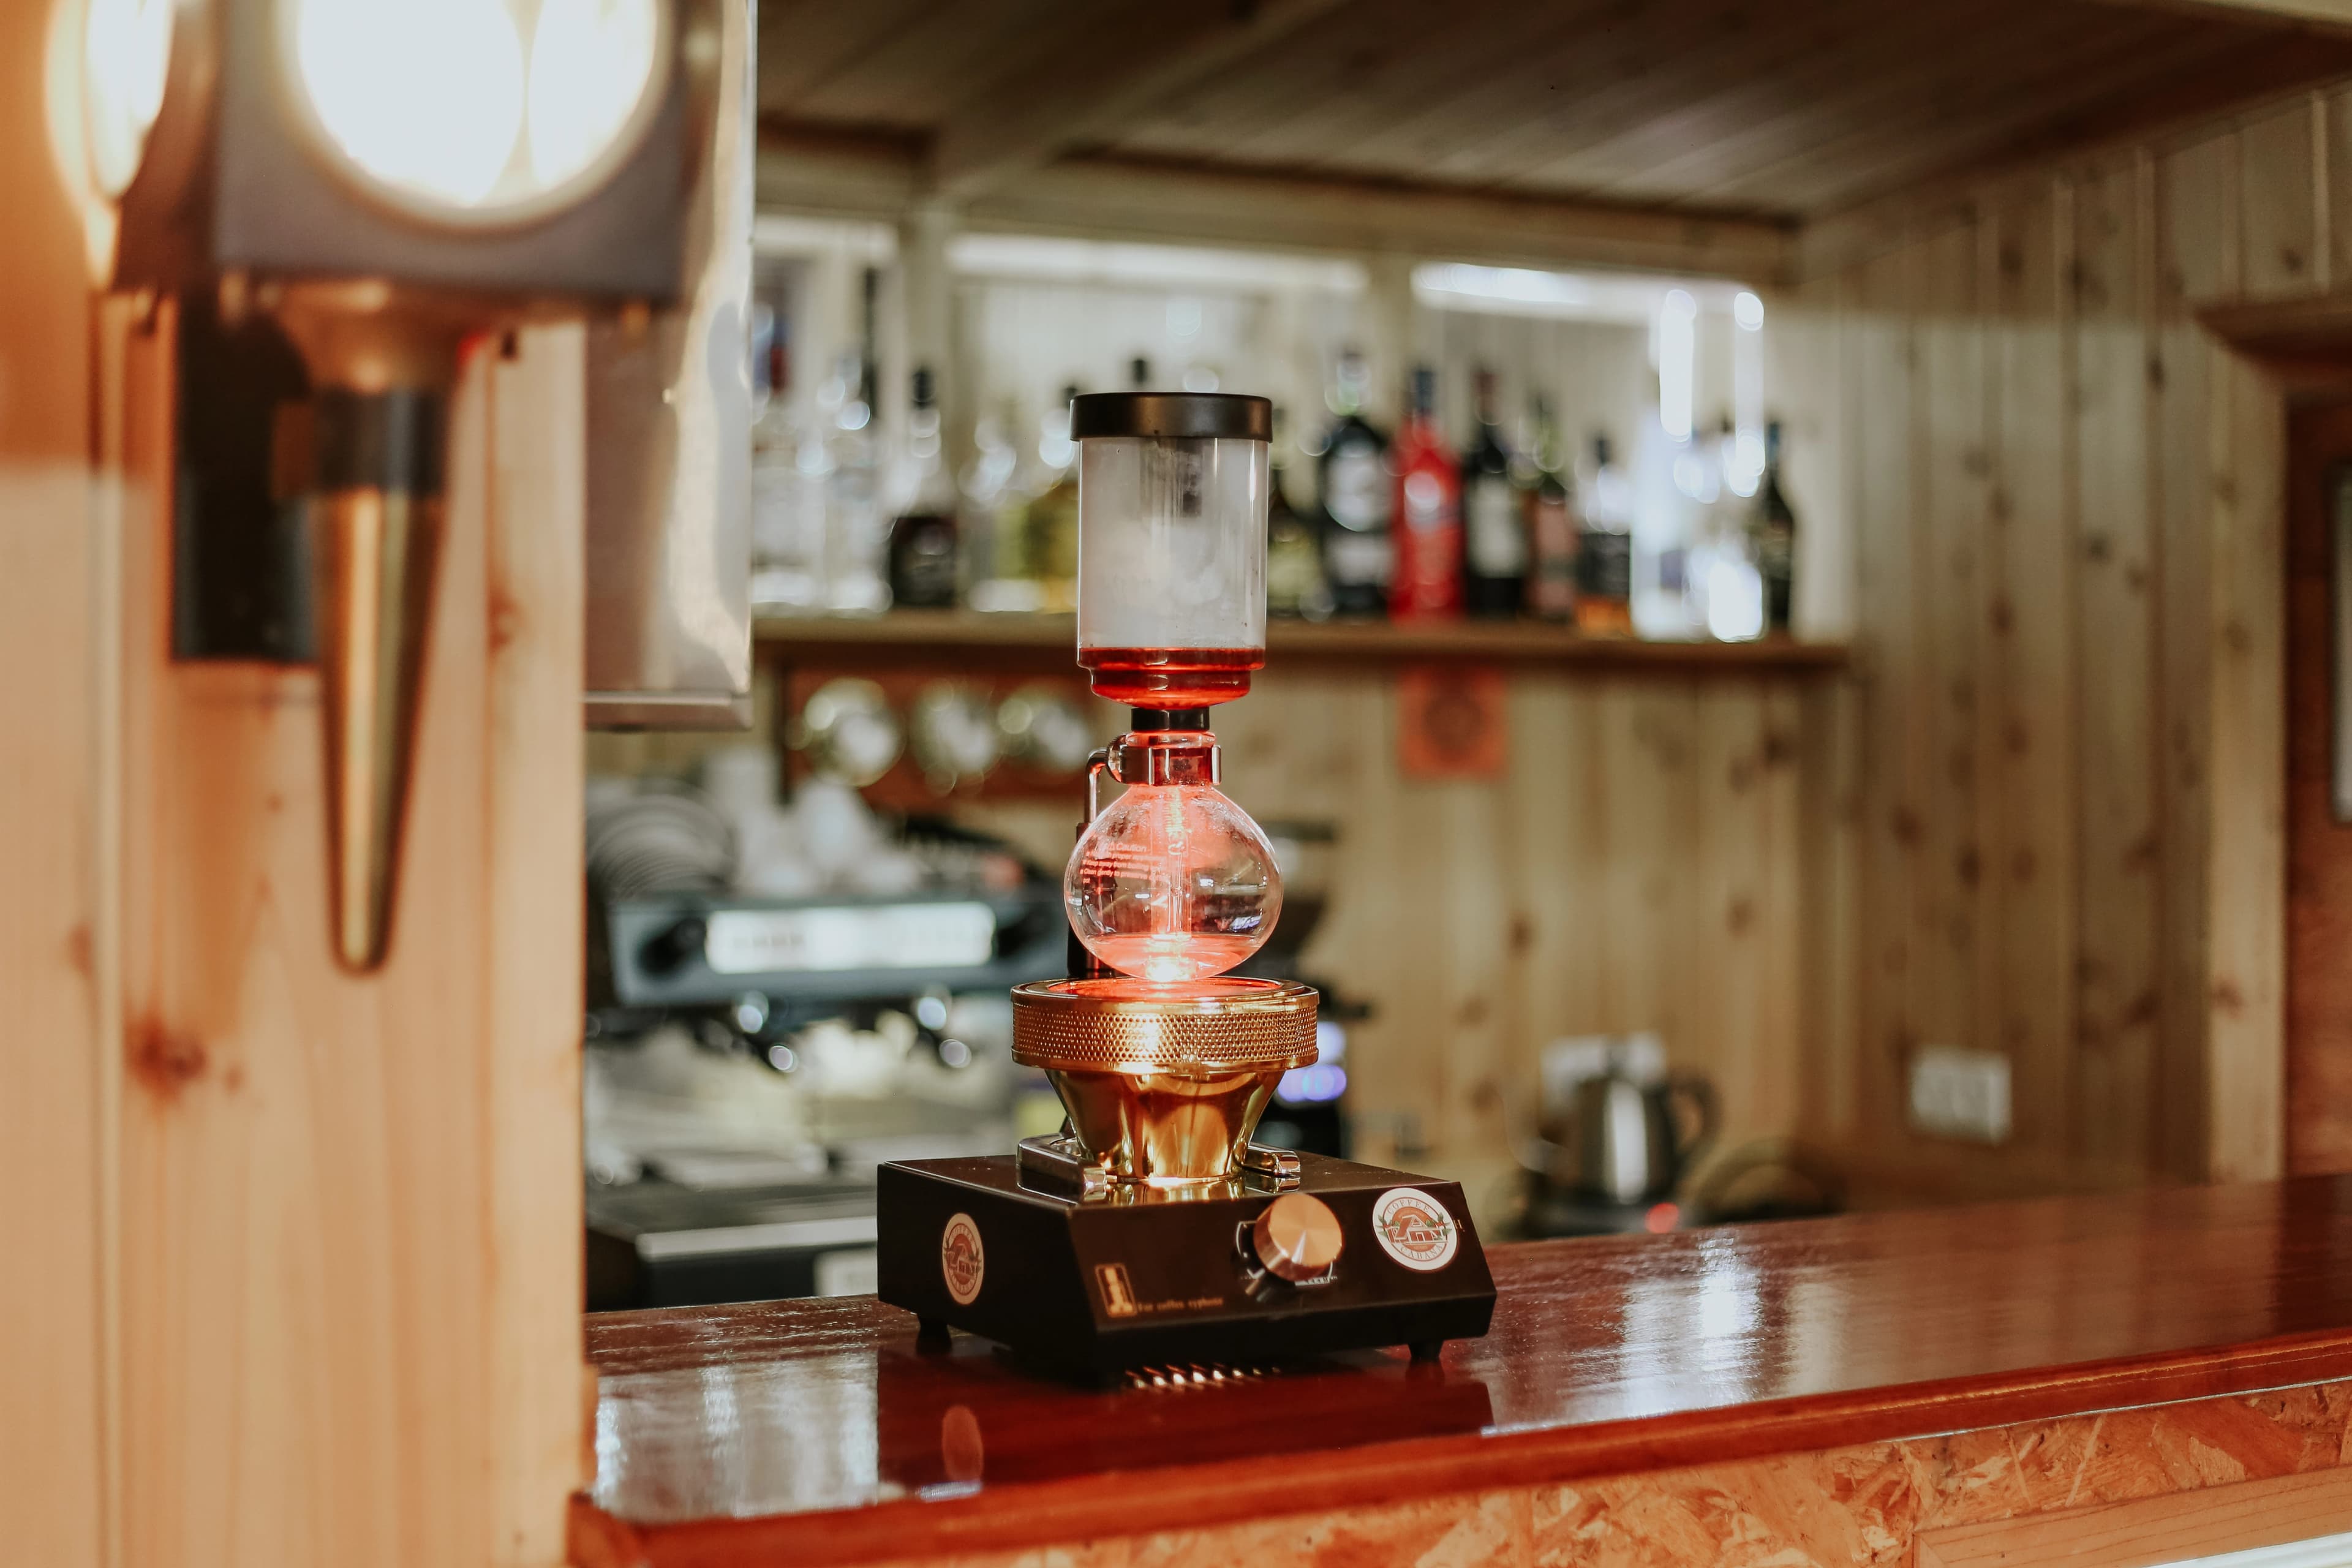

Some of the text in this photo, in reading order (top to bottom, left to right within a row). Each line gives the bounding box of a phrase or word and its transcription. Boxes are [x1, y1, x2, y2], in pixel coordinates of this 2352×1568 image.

[1117, 842, 1147, 852] Caution
[1097, 867, 1114, 877] gently
[1387, 1199, 1431, 1214] COFFEE
[1401, 1245, 1444, 1260] CABANA
